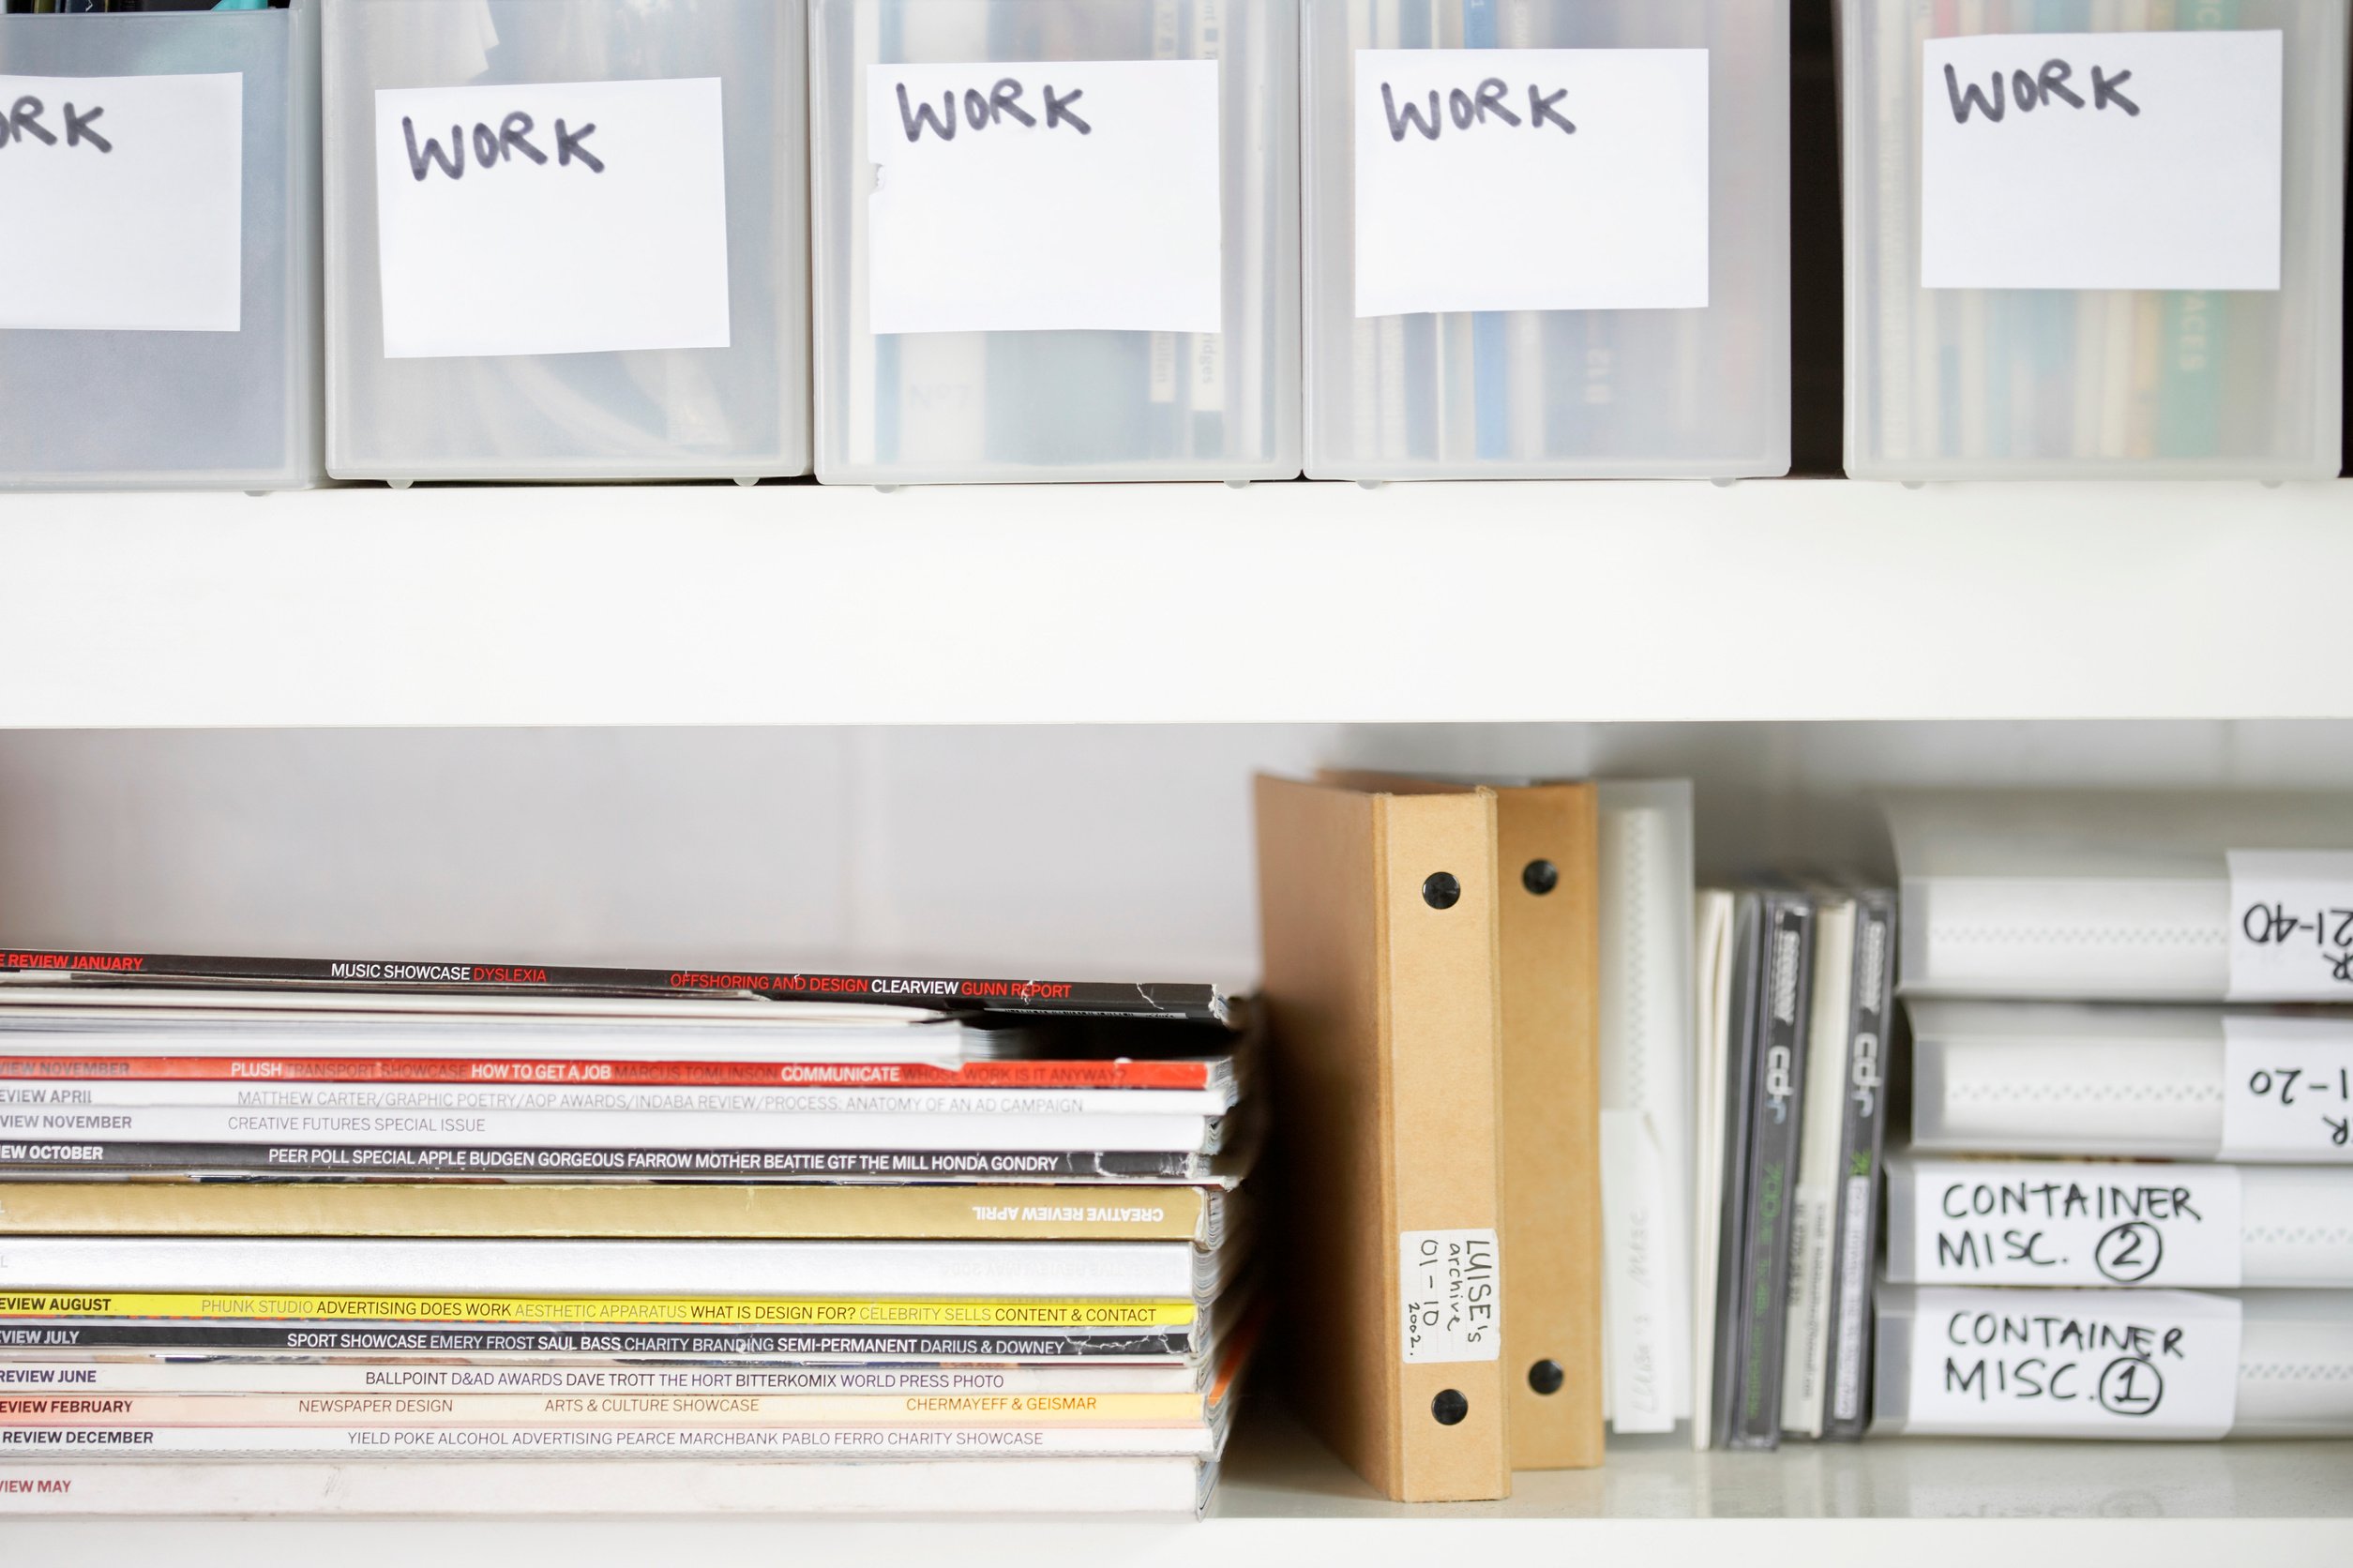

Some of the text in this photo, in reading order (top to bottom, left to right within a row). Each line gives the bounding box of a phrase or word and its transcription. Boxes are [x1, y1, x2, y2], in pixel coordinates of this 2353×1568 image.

[1943, 58, 2141, 125] WORK
[896, 77, 1093, 143] WORK
[1381, 77, 1577, 143] WORK
[401, 111, 607, 184] WORK
[8, 954, 69, 970] REVIEW
[70, 956, 144, 972] JANUARY
[331, 963, 547, 982] MUSIC SHOWCASE DYSLEXIA
[671, 973, 1072, 998] OFFSHORING AND DESIGN CLEARVIEW GUNN REPORT
[232, 1063, 281, 1077] PLUSH
[285, 1063, 376, 1078] TRANSPORT
[380, 1063, 466, 1078] SHOWCASE
[471, 1064, 509, 1078] HOW
[512, 1064, 533, 1078] TO
[535, 1064, 566, 1078] GET
[568, 1065, 581, 1078] A
[581, 1065, 611, 1078] JOB
[614, 1065, 680, 1078] MARCUS
[781, 1066, 900, 1079] COMMUNICATE
[965, 1068, 1011, 1079] WORK
[1015, 1068, 1029, 1080] IS
[1033, 1068, 1047, 1080] IT
[238, 1092, 313, 1107] MATTHEW
[317, 1093, 453, 1108] CARTER/GRAPHIC
[458, 1093, 556, 1108] POETRY/AOP
[563, 1094, 694, 1109] AWARDS/INDABA
[846, 1097, 922, 1111] ANATOMY
[926, 1098, 945, 1111] OF
[949, 1098, 972, 1111] AN
[976, 1098, 997, 1111] AD
[1001, 1098, 1083, 1112] CAMPAIGN
[42, 1116, 132, 1128] NOVEMBER
[228, 1117, 486, 1132] CREATIVE FUTURES SPECIAL ISSUE
[29, 1145, 103, 1160] OCTOBER
[269, 1149, 1059, 1171] PEER POLL SPECIAL APPLE BUDGEN GORGEOUS FARROW MOTHER BEATTIE GTF THE MILL HONDA GONDRY
[1941, 1182, 2203, 1223] CONTAINER
[973, 1207, 1164, 1222] CREATIVE REVIEW APRIL
[1447, 1244, 1464, 1332] archive
[50, 1298, 112, 1311] AUGUST
[201, 1300, 1156, 1321] PHUNK STUDIO ADVERTISING DOES WORK AESTHETIC APPARATUS WHAT IS DESIGN FOR? CELEBRITY SELLS CONTENT & CONTACT
[44, 1331, 80, 1344] JULY
[287, 1334, 1065, 1355] SPORT SHOWCASE EMERY FROST SAUL BASS CHARITY BRANDING SEMI-PERMANENT DARIUS & DOWNEY
[1948, 1312, 2185, 1361] CONTAINER
[58, 1370, 97, 1383] JUNE
[366, 1372, 1004, 1388] BALLPOINT D&AD AWARDS DAVE TROTT THE HORT BITTERKOMIX WORLD PRESS PHOTO
[51, 1400, 133, 1413] FEBRUARY
[298, 1399, 453, 1412] NEWSPAPER DESIGN
[545, 1398, 760, 1412] ARTS & CULTURE SHOWCASE
[906, 1397, 1096, 1410] CHERMAYEFF & GEISMAR
[3, 1431, 154, 1444] REVIEW DECEMBER
[348, 1431, 1043, 1445] YIELD POKE ALCOHOL ADVERTISING PEARCE MARCHBANK PABLO FERRO CHARITY SHOWCASE
[37, 1480, 72, 1493] MAY
